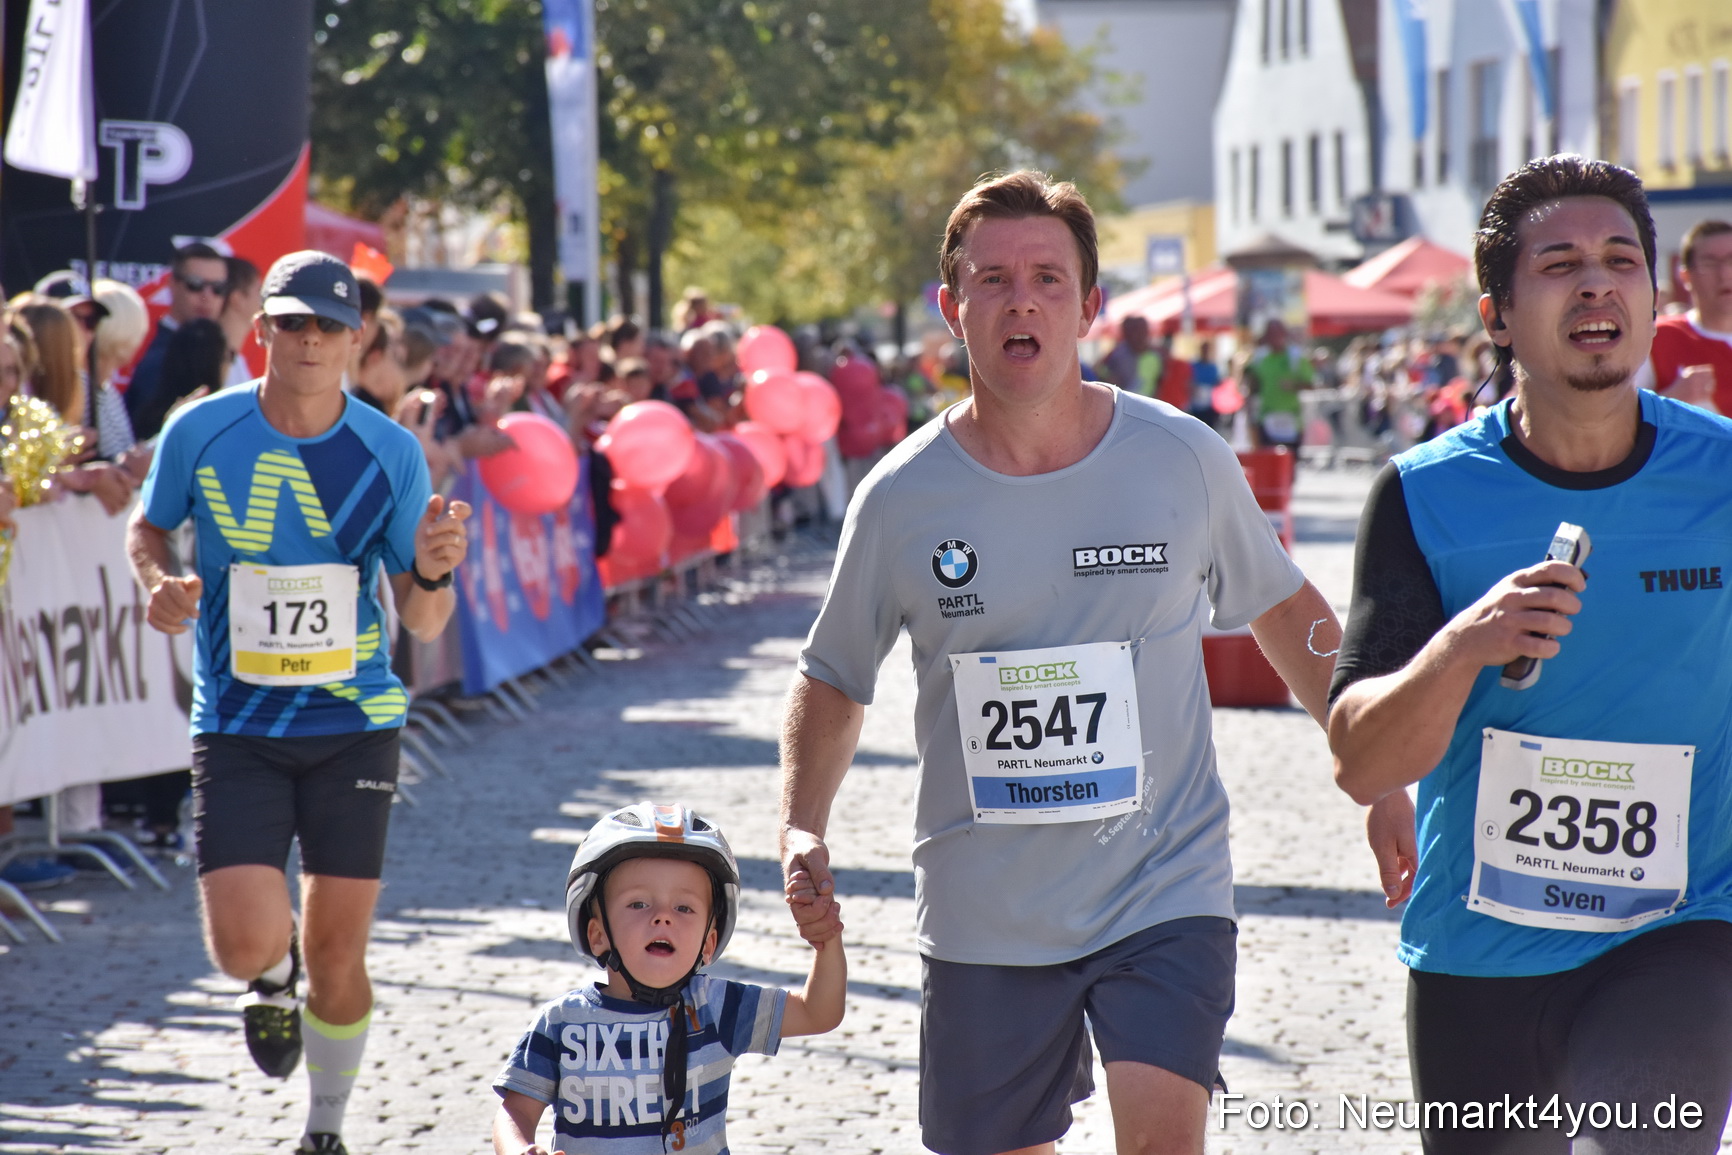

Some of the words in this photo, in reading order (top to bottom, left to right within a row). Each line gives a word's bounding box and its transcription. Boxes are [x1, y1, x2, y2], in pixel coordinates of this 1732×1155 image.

[1073, 543, 1168, 569] BOCK
[268, 576, 323, 591] BOCK
[1074, 568, 1104, 578] inspired
[1106, 567, 1115, 576] by
[1117, 567, 1139, 575] smart
[1140, 566, 1169, 575] concepts
[1639, 566, 1723, 593] THULE
[938, 594, 983, 610] PARTL
[941, 607, 985, 619] Neumarkt
[263, 599, 328, 636] 173
[281, 658, 312, 673] Petr
[999, 661, 1079, 684] BOCK
[1001, 684, 1024, 692] inspired
[1053, 679, 1081, 688] concepts
[981, 692, 1107, 750] 2547
[997, 759, 1032, 770] PARTL
[1034, 755, 1088, 768] Neumarkt
[1541, 757, 1635, 783] BOCK
[1005, 780, 1099, 804] Thorsten
[1540, 777, 1569, 786] inspired
[1570, 779, 1579, 787] by
[1580, 780, 1602, 788] smart
[1603, 783, 1635, 791] concepts
[1505, 788, 1658, 858] 2358
[1515, 854, 1559, 871] PARTL
[1562, 862, 1625, 878] Neumarkt
[1544, 884, 1606, 912] Sven
[560, 1020, 671, 1072] SIXTH
